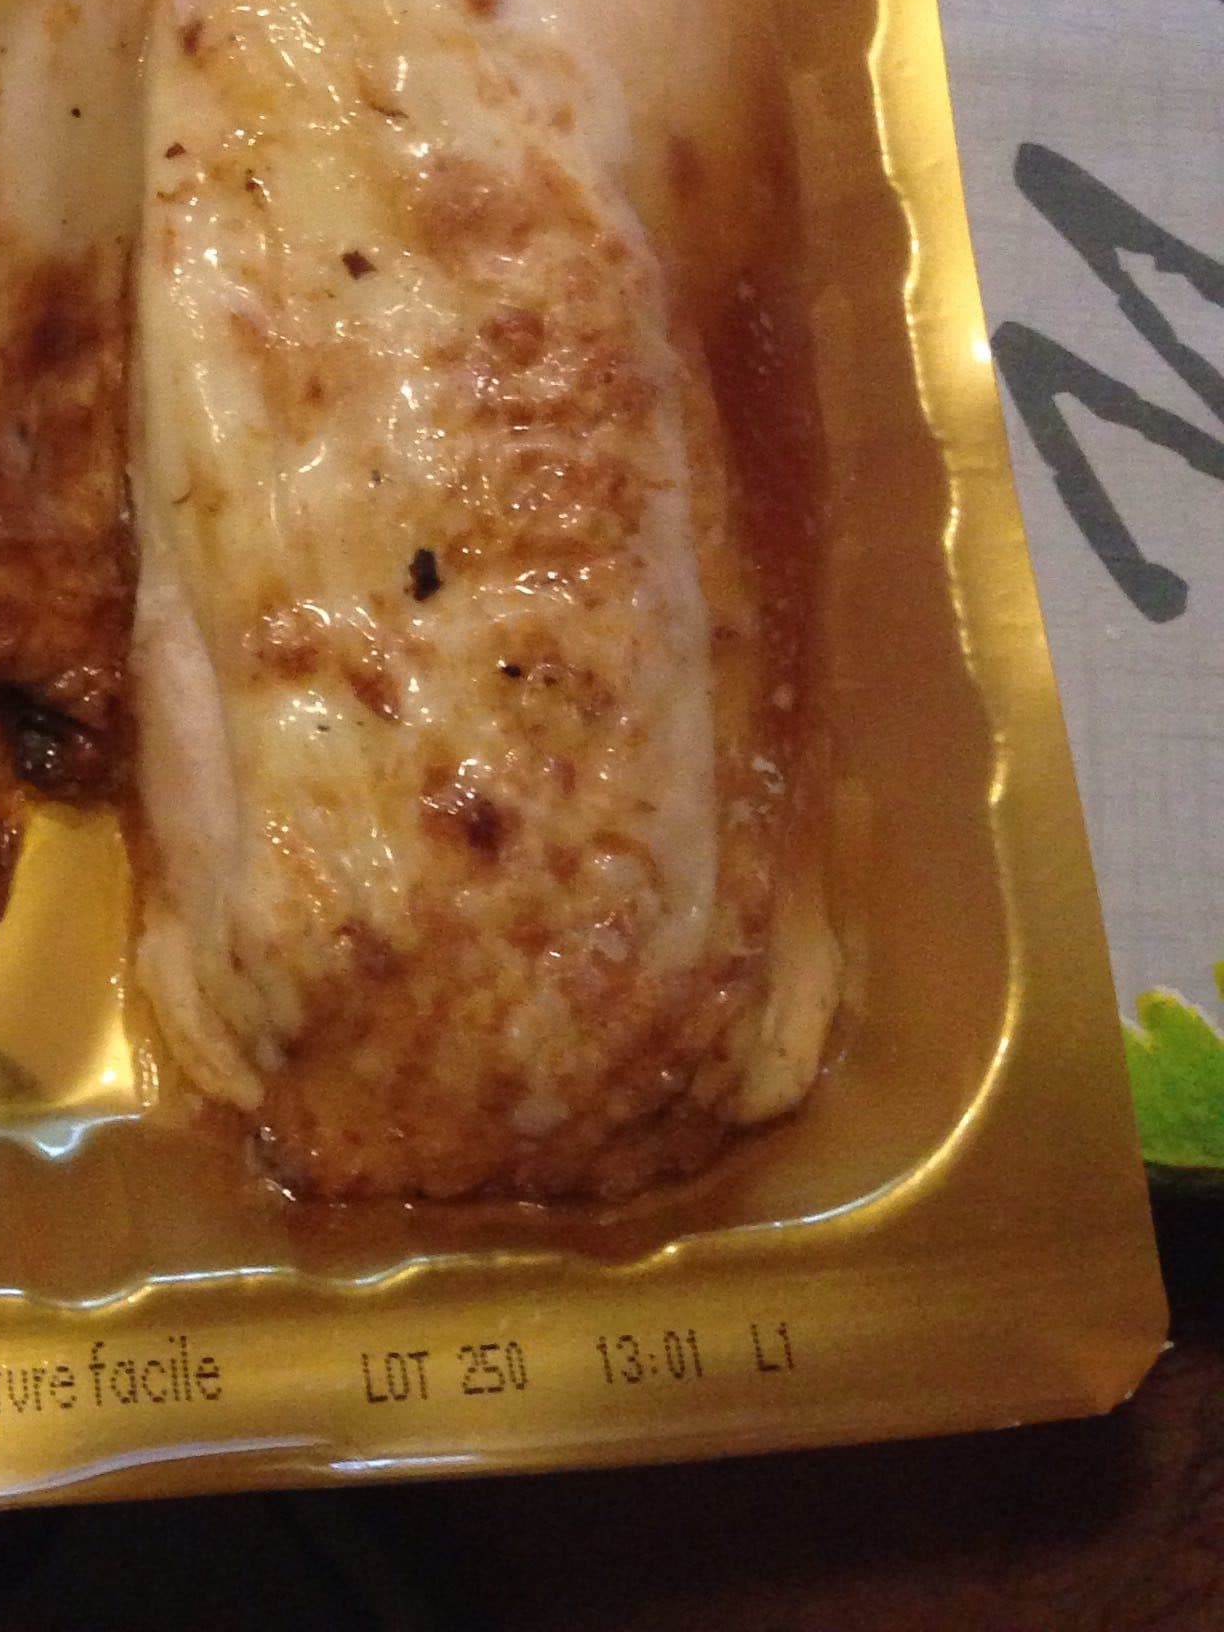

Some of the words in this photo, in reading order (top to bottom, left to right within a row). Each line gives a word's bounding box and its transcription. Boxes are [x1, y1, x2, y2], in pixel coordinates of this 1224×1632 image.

[89, 1335, 223, 1407] facile
[361, 1350, 430, 1404] LOT
[458, 1341, 528, 1395] 250
[596, 1328, 704, 1385] 13:01
[749, 1321, 795, 1371] L1
